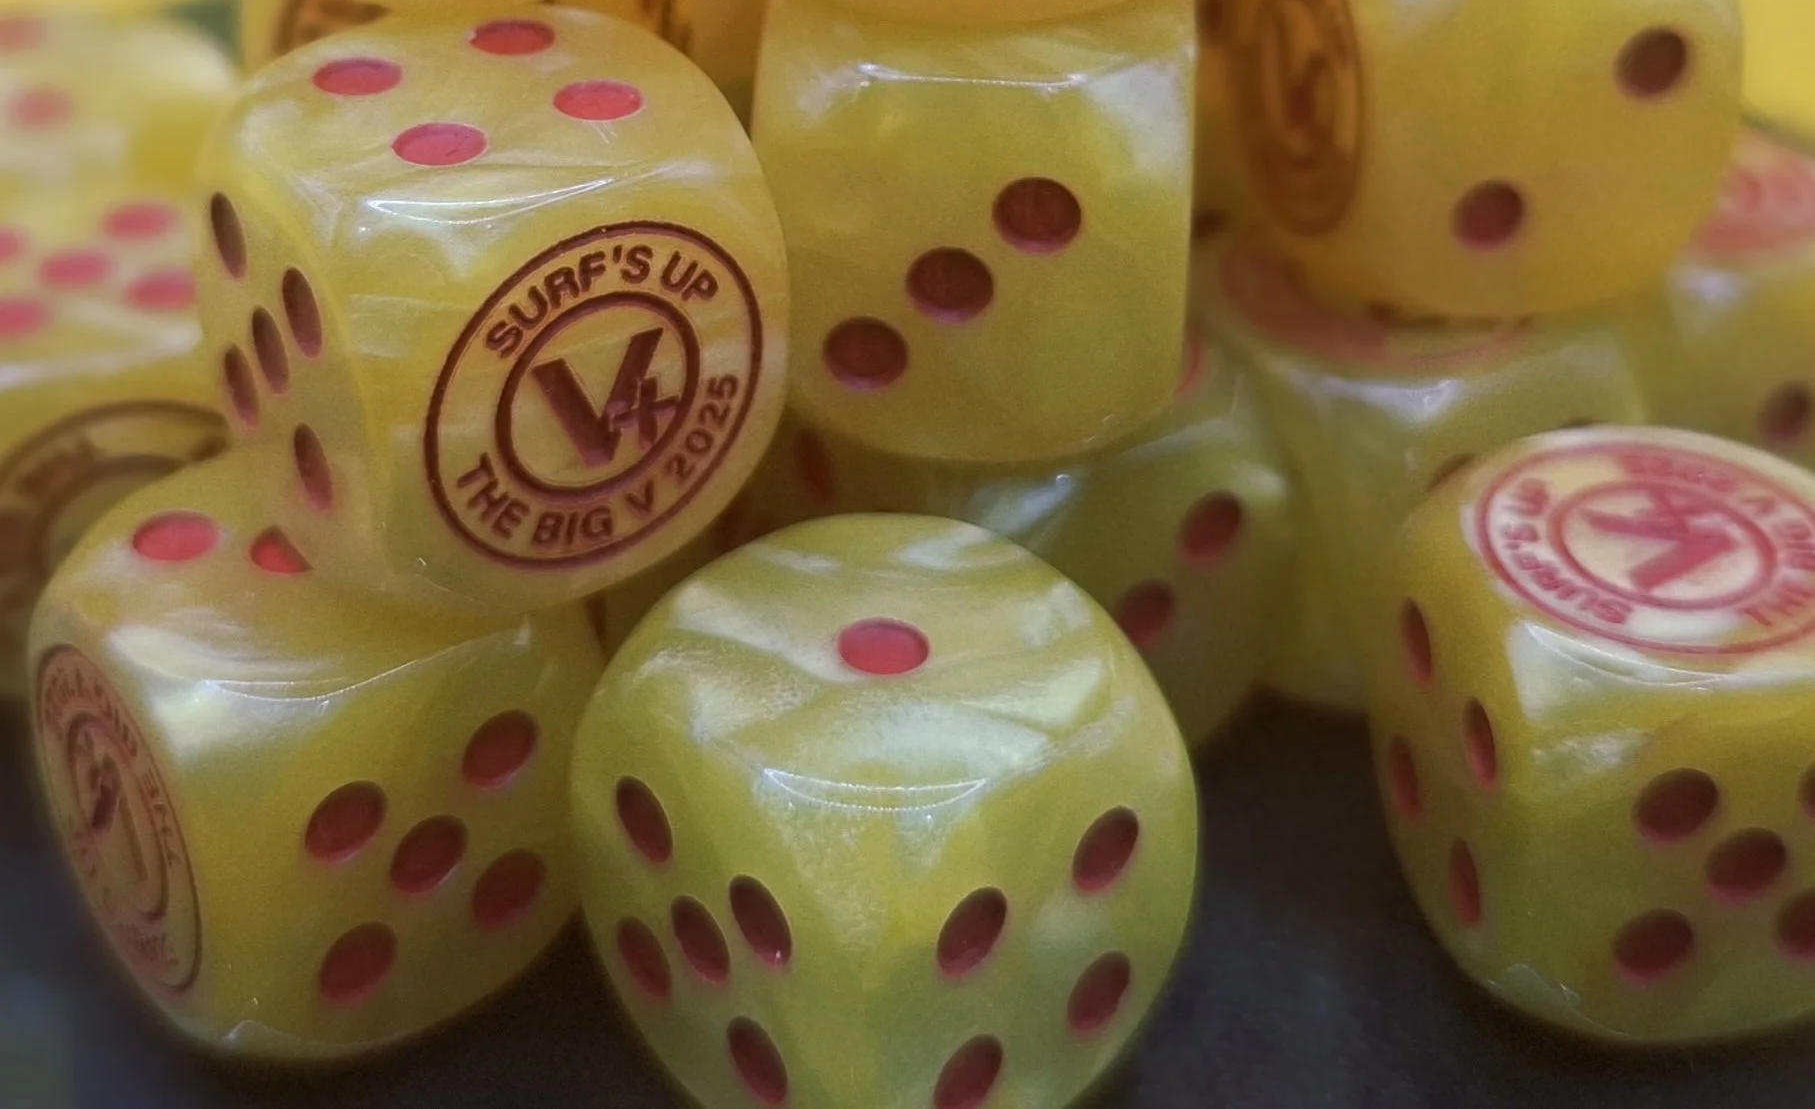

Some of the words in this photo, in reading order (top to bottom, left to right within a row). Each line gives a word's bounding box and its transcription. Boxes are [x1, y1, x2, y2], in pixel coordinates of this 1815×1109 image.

[484, 245, 654, 359] SURF'S
[661, 251, 721, 302] UP
[456, 451, 530, 540] THE
[531, 505, 615, 548] BIG
[626, 478, 656, 519] V
[667, 372, 739, 488] 2025
